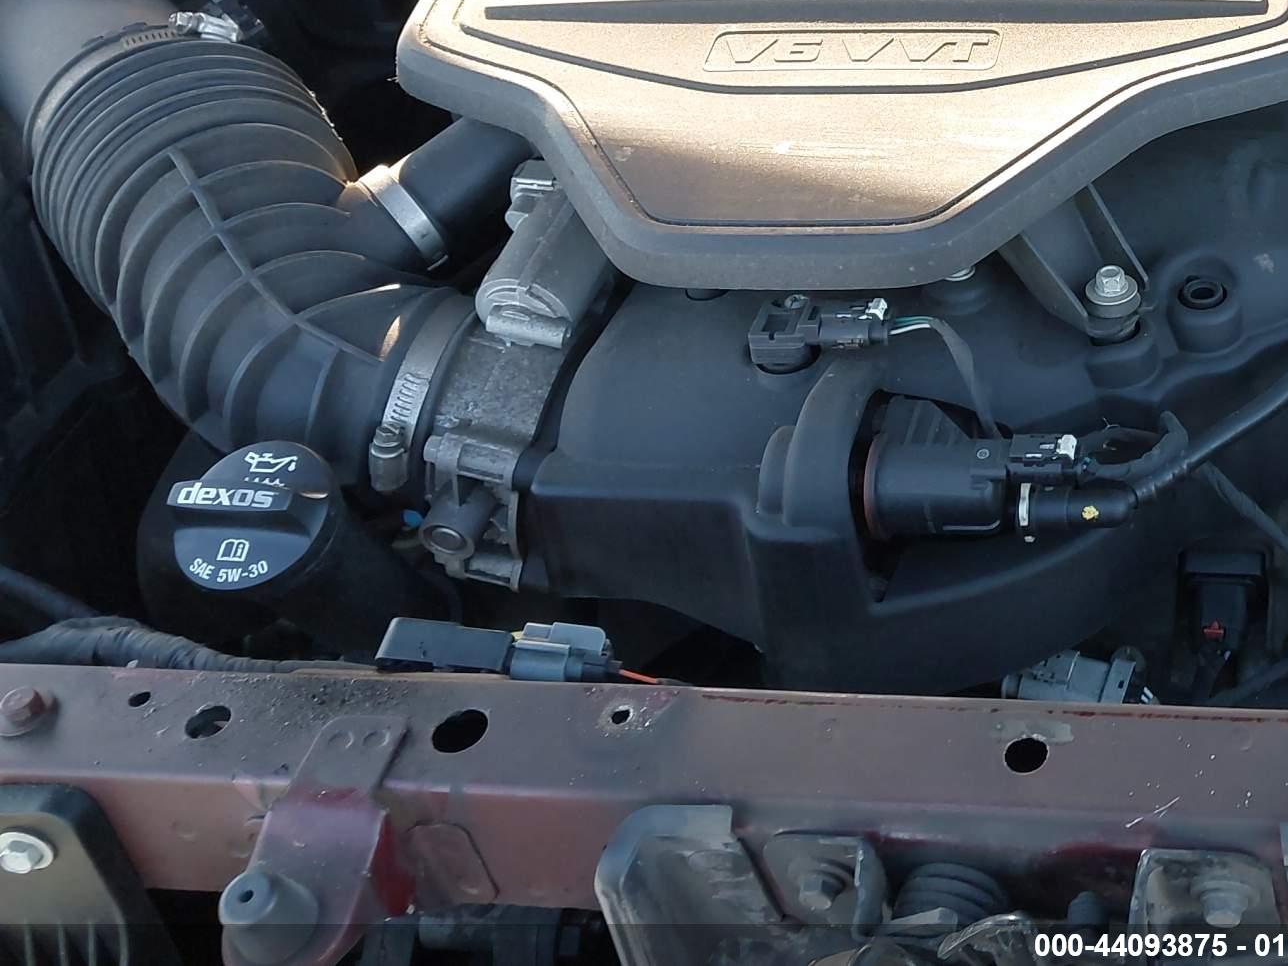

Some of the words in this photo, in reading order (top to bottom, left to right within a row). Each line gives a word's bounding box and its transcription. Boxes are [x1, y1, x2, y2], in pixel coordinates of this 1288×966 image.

[725, 37, 824, 64] V6
[841, 37, 991, 64] VVT
[177, 482, 275, 509] dexos
[189, 557, 216, 580] SAE
[216, 559, 269, 583] 5W-30
